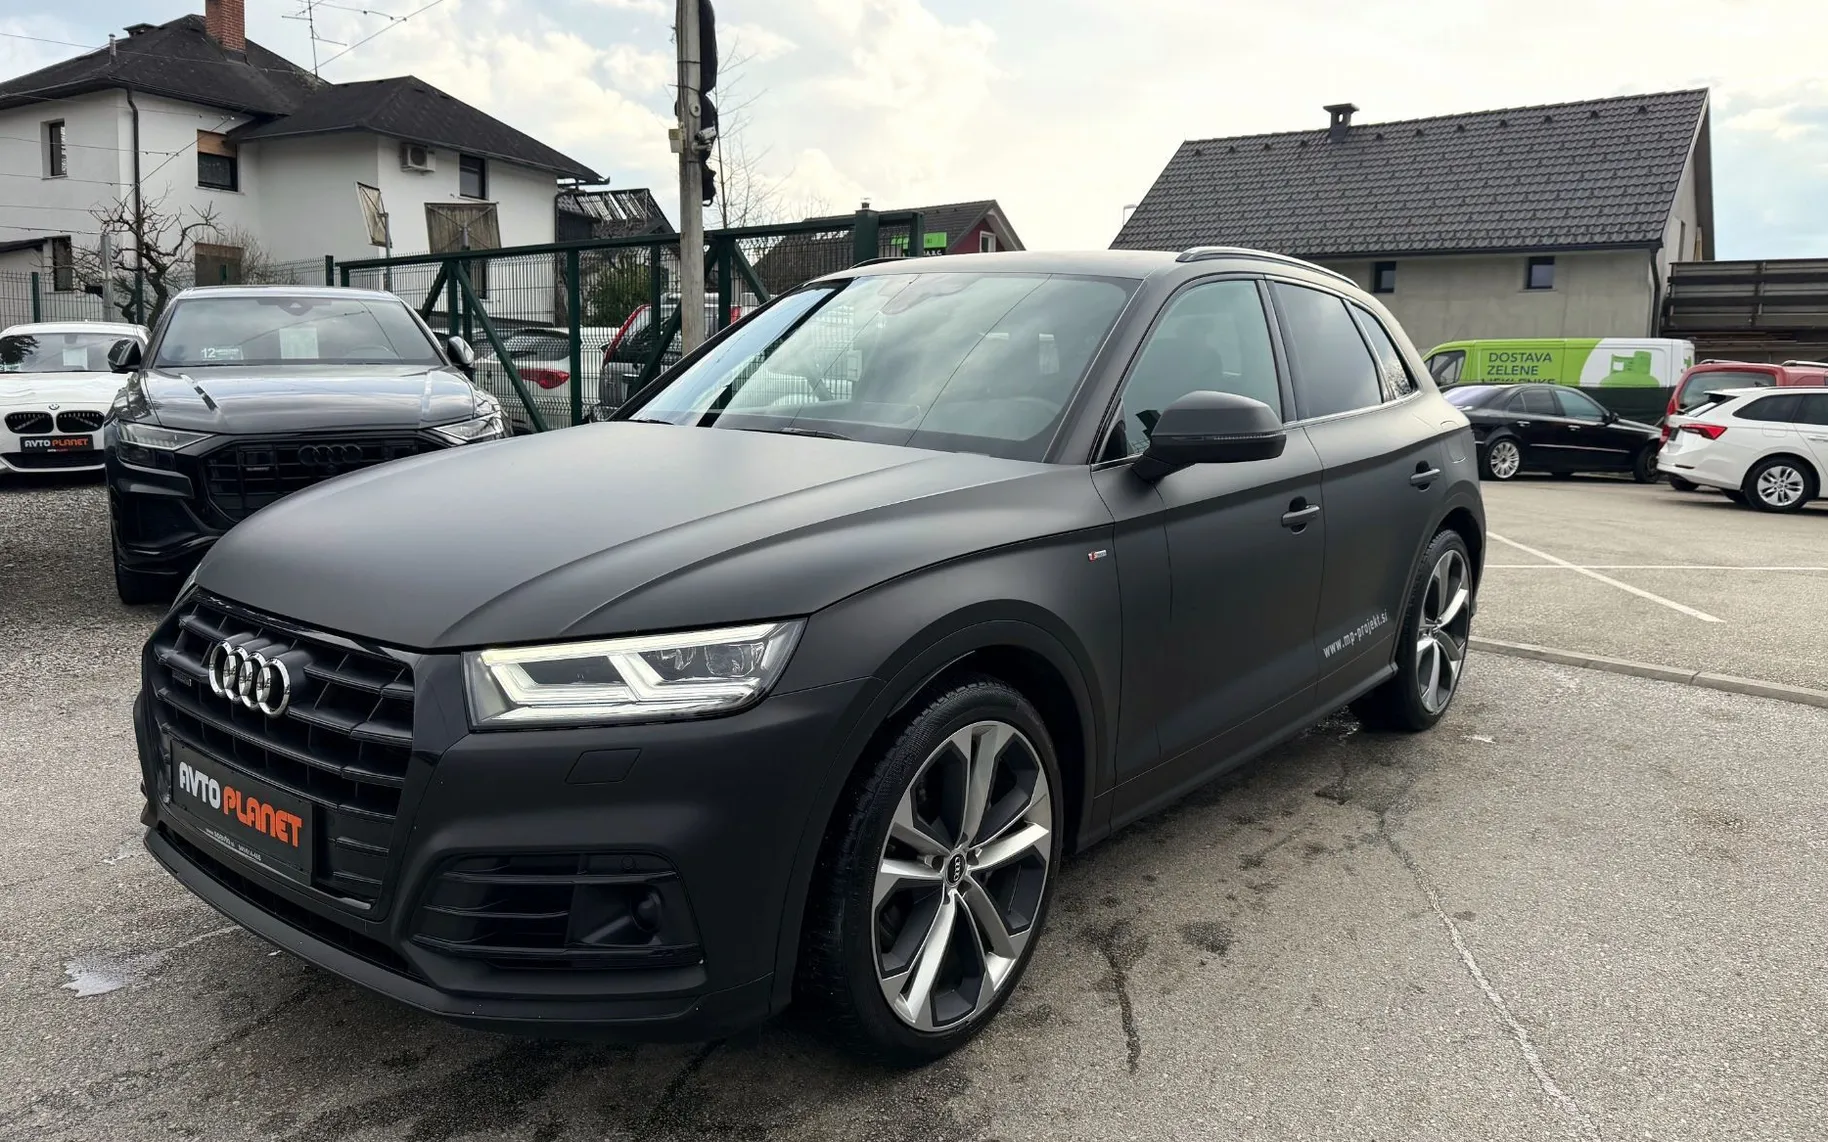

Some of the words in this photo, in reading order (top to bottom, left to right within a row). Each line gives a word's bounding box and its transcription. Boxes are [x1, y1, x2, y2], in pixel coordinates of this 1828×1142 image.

[1488, 352, 1553, 363] DOSTAVA
[1487, 365, 1539, 376] ZELENE
[24, 439, 51, 448] AVTO
[52, 438, 89, 447] PLANET
[1322, 608, 1388, 659] www.mp-projekt.si
[178, 761, 221, 810] AVTO
[223, 785, 303, 848] PLANET
